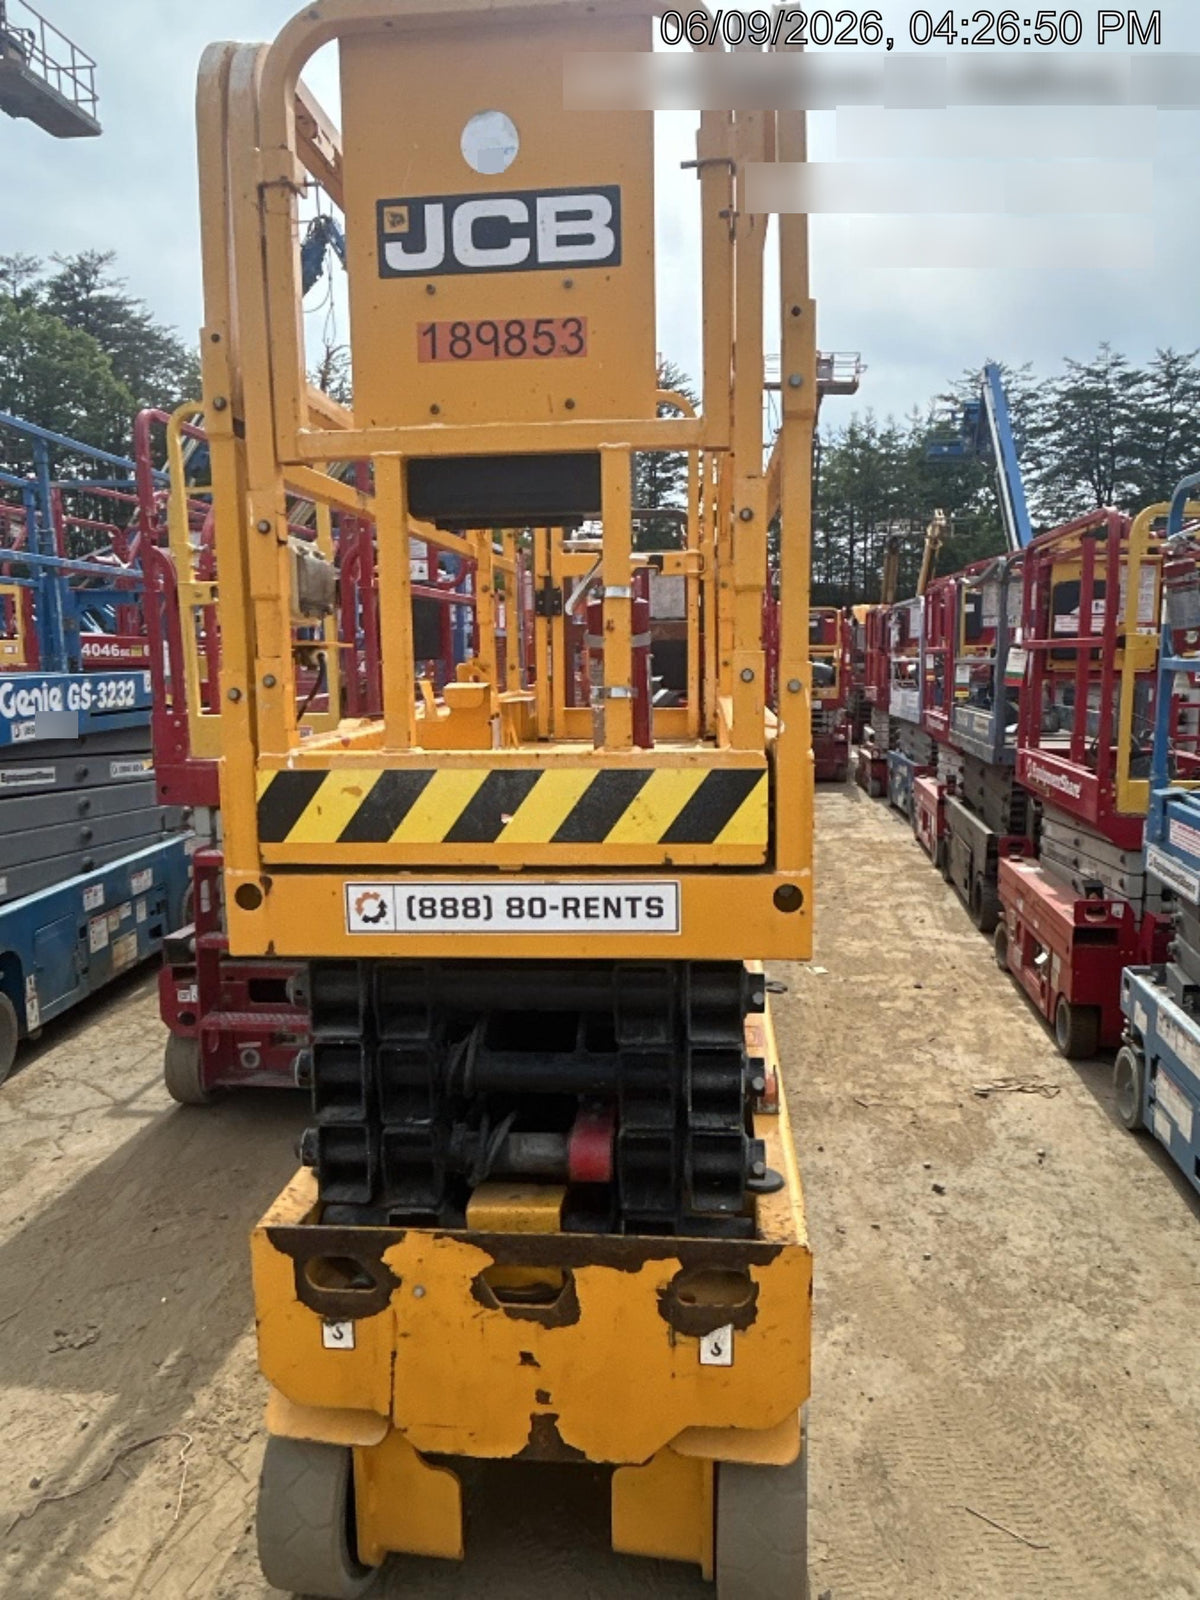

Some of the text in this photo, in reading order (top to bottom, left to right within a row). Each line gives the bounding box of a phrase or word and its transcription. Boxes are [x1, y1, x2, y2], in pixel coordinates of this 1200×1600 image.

[385, 194, 615, 271] JCB
[422, 318, 584, 360] 189853
[0, 680, 136, 719] Genie GS-3232
[406, 895, 665, 921] (888) 80-RENTS
